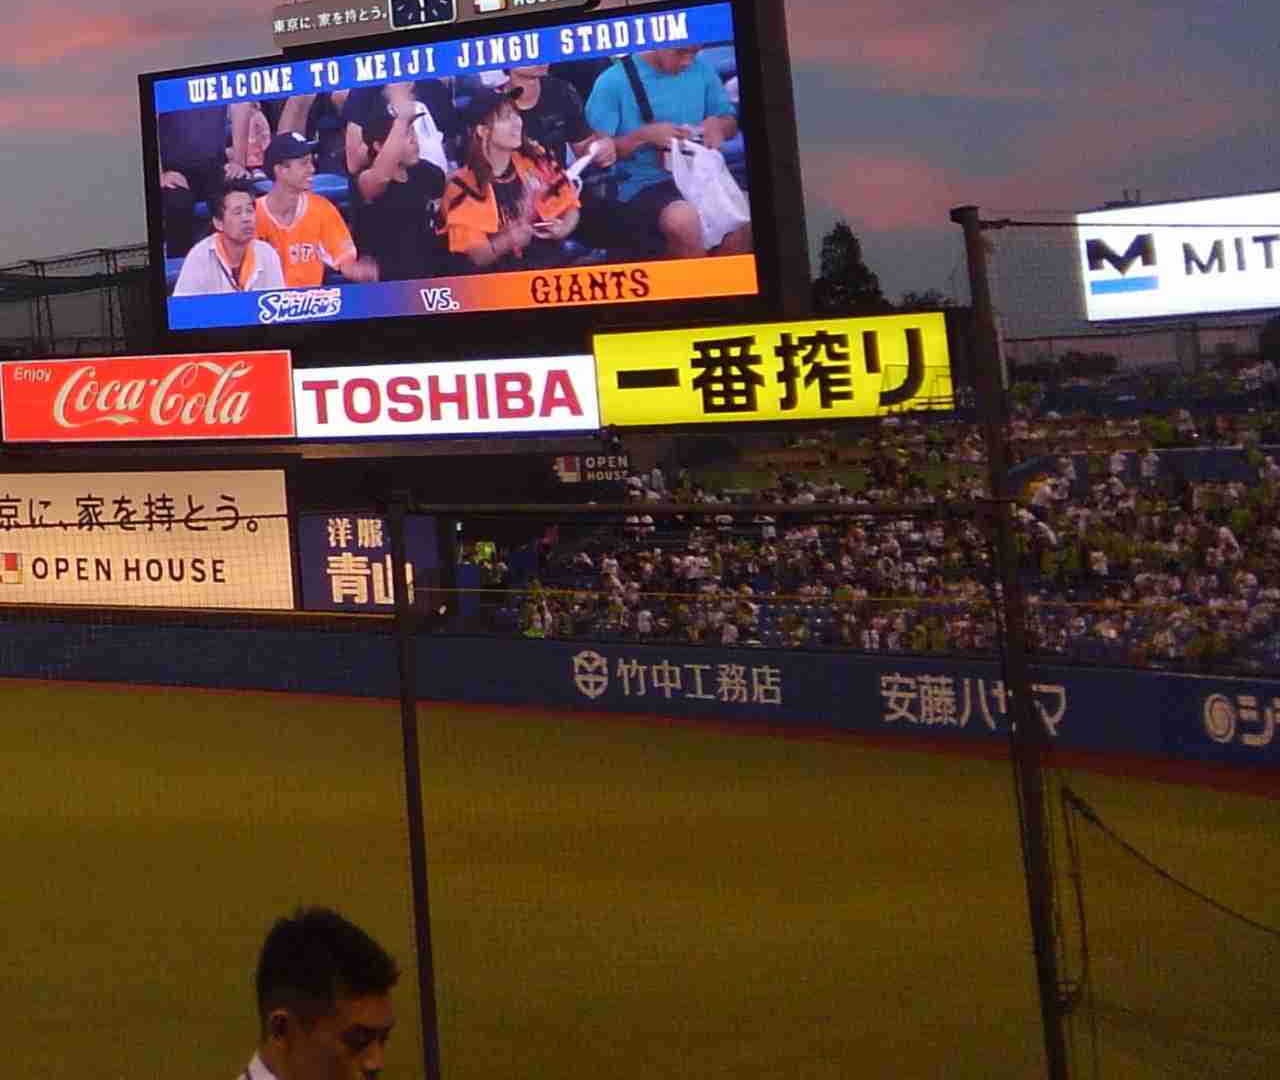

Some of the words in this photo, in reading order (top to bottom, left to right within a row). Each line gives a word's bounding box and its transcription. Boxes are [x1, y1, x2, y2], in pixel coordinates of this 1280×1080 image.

[188, 67, 293, 103] WELCOME
[309, 61, 339, 88] TO
[355, 47, 436, 82] MEIJI
[457, 33, 540, 68] JINGU
[560, 12, 689, 55] STADIUM
[531, 269, 650, 304] GIANTS
[13, 366, 53, 382] Enjoy
[616, 327, 926, 414] 一番搾り
[301, 369, 584, 424] TOSHIBA
[585, 455, 629, 469] OPEN
[32, 557, 112, 582] OPEN
[124, 558, 226, 584] HOUSE
[615, 657, 783, 705] 竹中工務店
